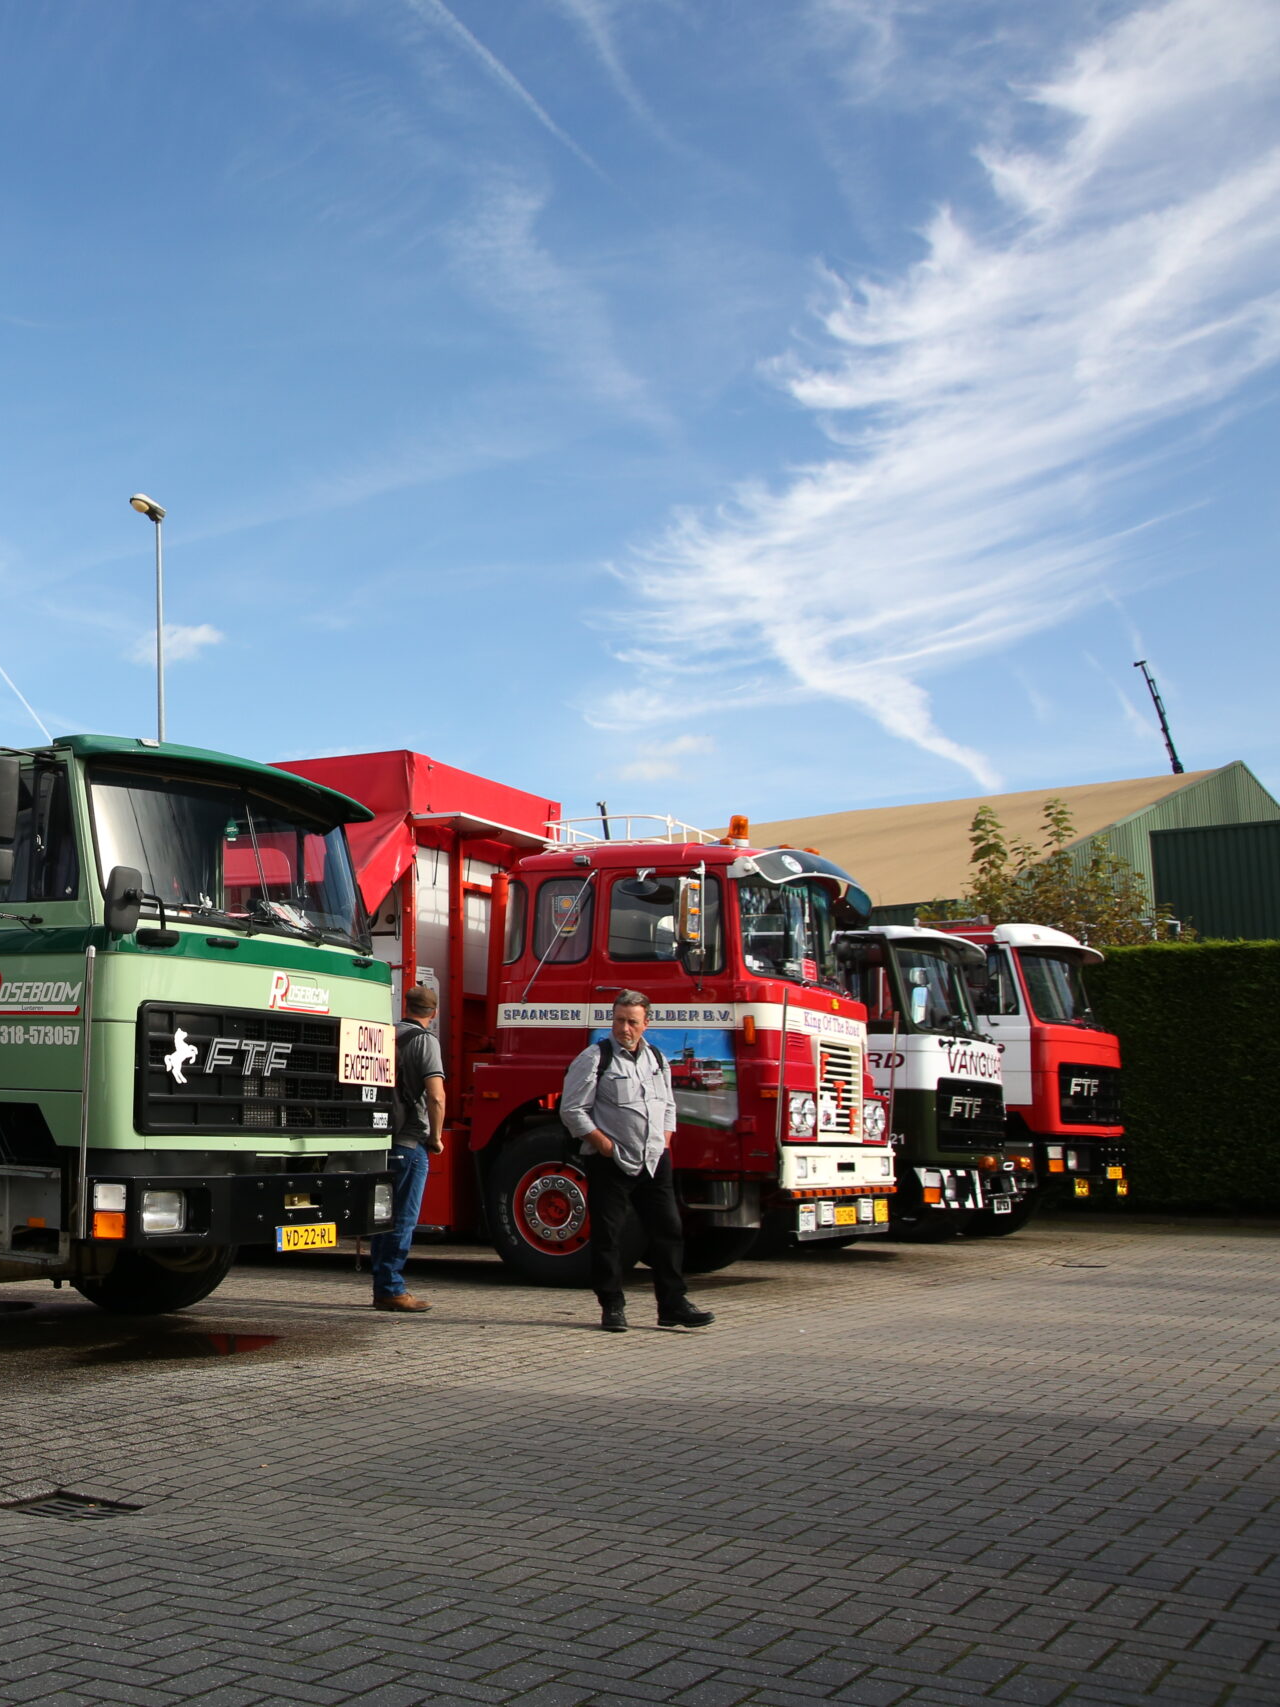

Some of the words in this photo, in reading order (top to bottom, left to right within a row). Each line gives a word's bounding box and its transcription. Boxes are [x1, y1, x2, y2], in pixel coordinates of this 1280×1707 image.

[268, 970, 330, 1009] ROSEBOOM
[503, 1008, 581, 1021] SPAANSEN
[703, 1009, 734, 1022] B.V.
[804, 1011, 821, 1033] King
[357, 1025, 384, 1055] CONVOI
[204, 1038, 293, 1076] FTF
[344, 1053, 392, 1084] EXCEPTIONNEL
[1070, 1078, 1099, 1097] FTF
[949, 1096, 981, 1118] FTF
[286, 1228, 333, 1246] VD-22-RL
